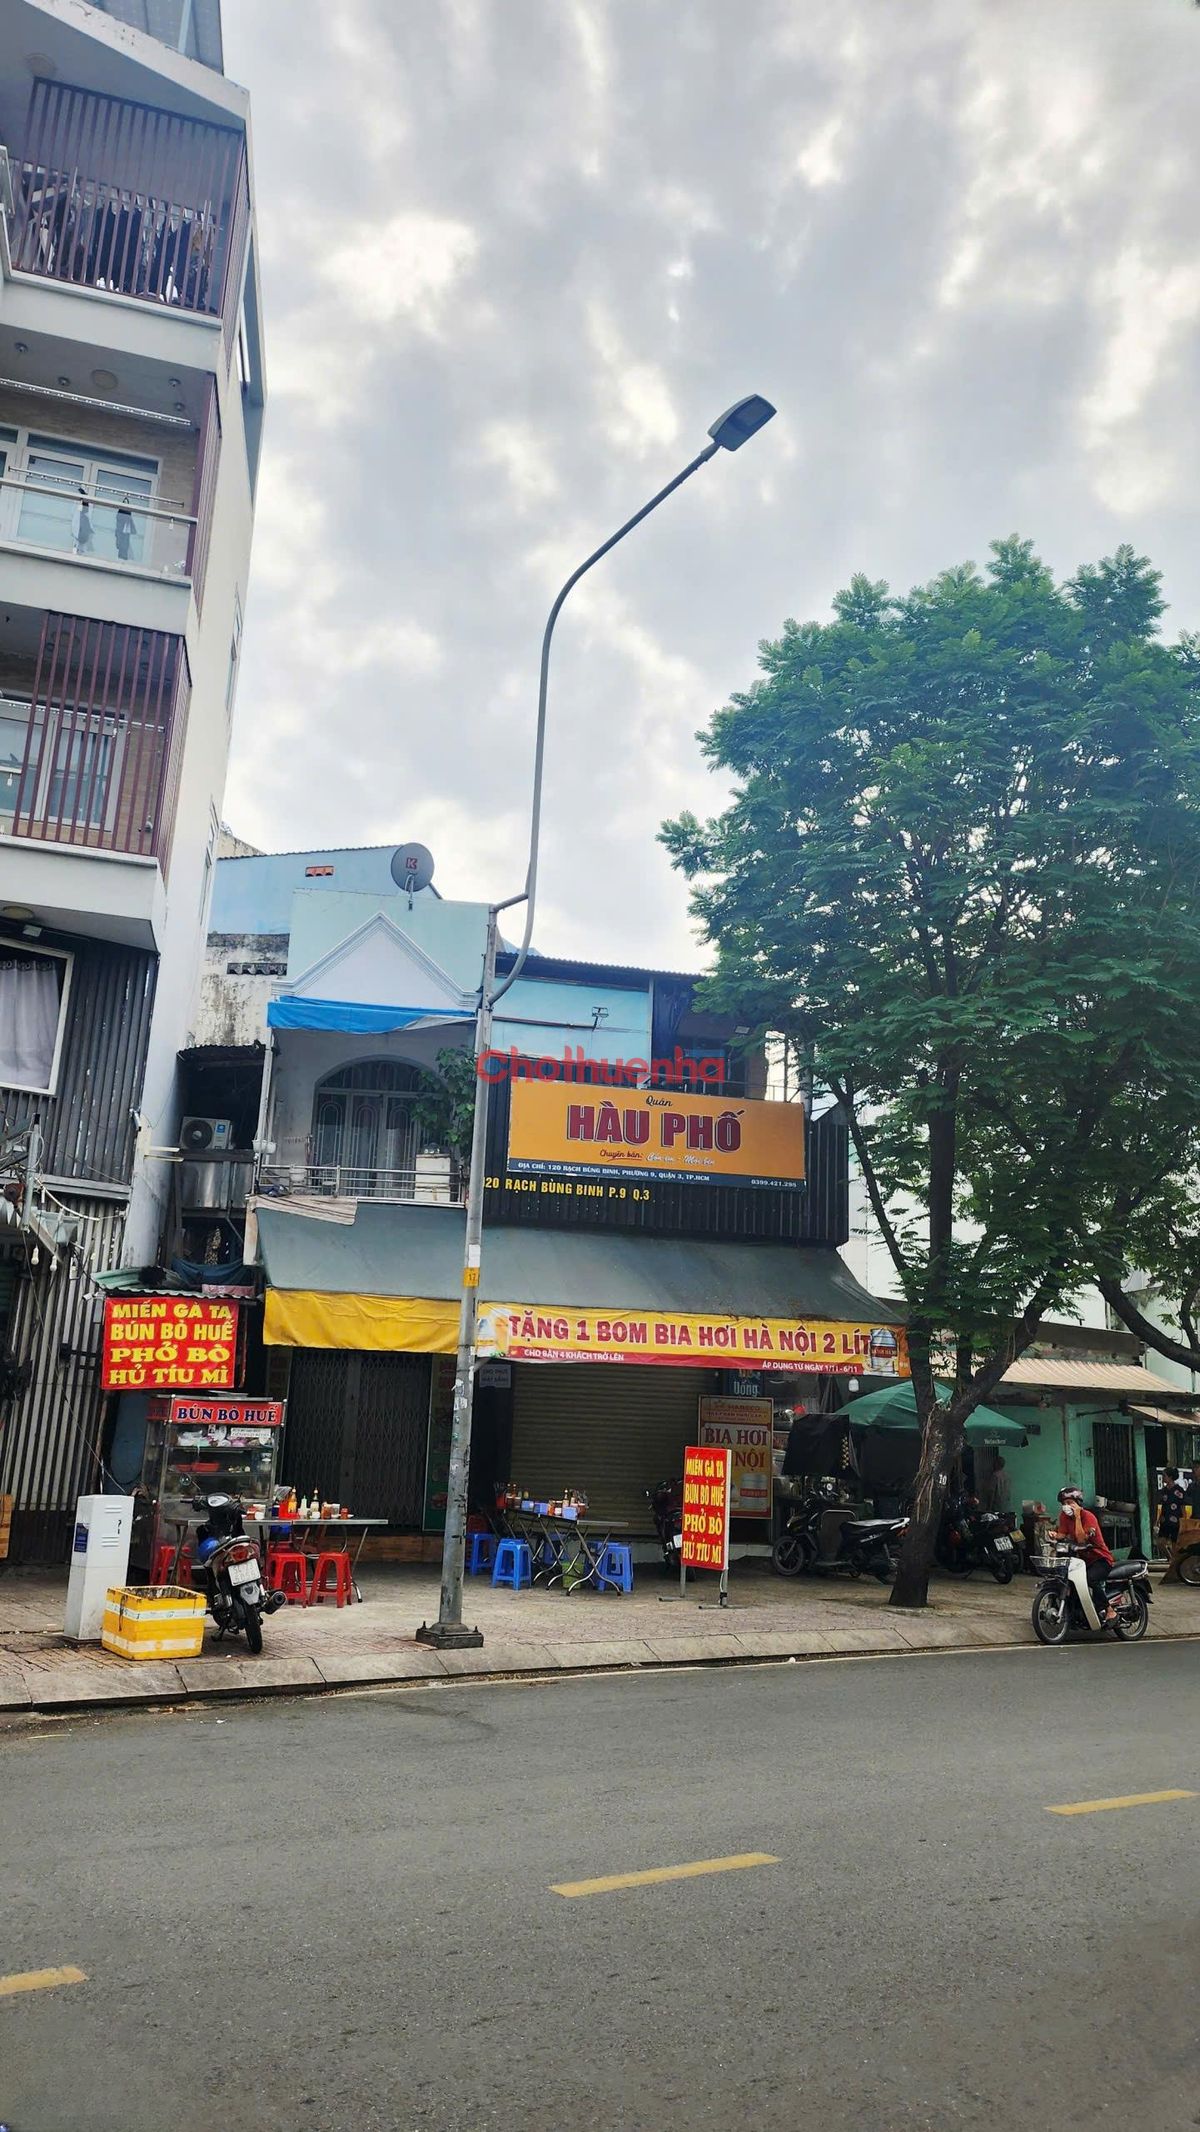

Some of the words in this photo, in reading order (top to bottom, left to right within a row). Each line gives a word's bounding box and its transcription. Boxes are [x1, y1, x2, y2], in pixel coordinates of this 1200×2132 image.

[645, 1095, 673, 1107] Quán
[567, 1101, 650, 1145] HÀU
[660, 1110, 745, 1153] PHỐ
[518, 1162, 530, 1170] ĐỊA
[658, 1171, 676, 1180] QUẬN
[685, 1173, 710, 1181] TP.HCM
[505, 1178, 537, 1194] RẠCH
[540, 1178, 573, 1195] BÙNG
[576, 1183, 604, 1197] BINH
[608, 1186, 626, 1199] P.9
[632, 1189, 650, 1201] Q.3
[112, 1299, 166, 1319] MIẾN
[173, 1301, 203, 1318] GÀ
[209, 1305, 232, 1319] TA
[110, 1321, 155, 1341] BÚN
[160, 1320, 187, 1340] BÒ
[193, 1319, 234, 1341] HUẾ
[508, 1310, 569, 1342] TẶNG
[576, 1319, 590, 1341] 1
[597, 1320, 648, 1344] BOM
[654, 1323, 693, 1346] BIA
[698, 1324, 737, 1348] HƠI
[743, 1323, 774, 1350] HÀ
[779, 1325, 817, 1356] NỘI
[823, 1333, 836, 1354] 2
[841, 1328, 871, 1355] LÍT
[110, 1341, 178, 1363] PHỞ
[186, 1343, 230, 1363] BÒ
[524, 1349, 541, 1357] CHO
[542, 1349, 558, 1358] BÀN
[565, 1351, 593, 1360] KHÁCH
[593, 1352, 609, 1360] TRỞ
[609, 1353, 625, 1361] LÊN
[109, 1363, 147, 1384] HỦ
[152, 1364, 195, 1384] TÍU
[201, 1365, 229, 1384] MÌ
[762, 1360, 772, 1369] ÁP
[772, 1362, 793, 1370] DỤNG
[804, 1363, 824, 1371] NGÀY
[177, 1404, 213, 1420] BÚN
[217, 1406, 240, 1421] BÒ
[243, 1404, 278, 1422] HUẾ
[704, 1427, 732, 1445] BIA
[736, 1429, 768, 1446] HƠI
[685, 1453, 703, 1476] MIẾN
[704, 1456, 715, 1477] GÀ
[716, 1460, 724, 1478] TA
[735, 1448, 765, 1471] NỘI
[684, 1479, 699, 1504] BÚN
[700, 1479, 710, 1506] BÒ
[710, 1479, 725, 1507] HUẾ
[683, 1507, 706, 1533] PHỞ
[708, 1511, 723, 1535] BÒ
[682, 1534, 696, 1560] HỦ
[696, 1537, 711, 1562] TÍU
[711, 1540, 722, 1564] MÌ
